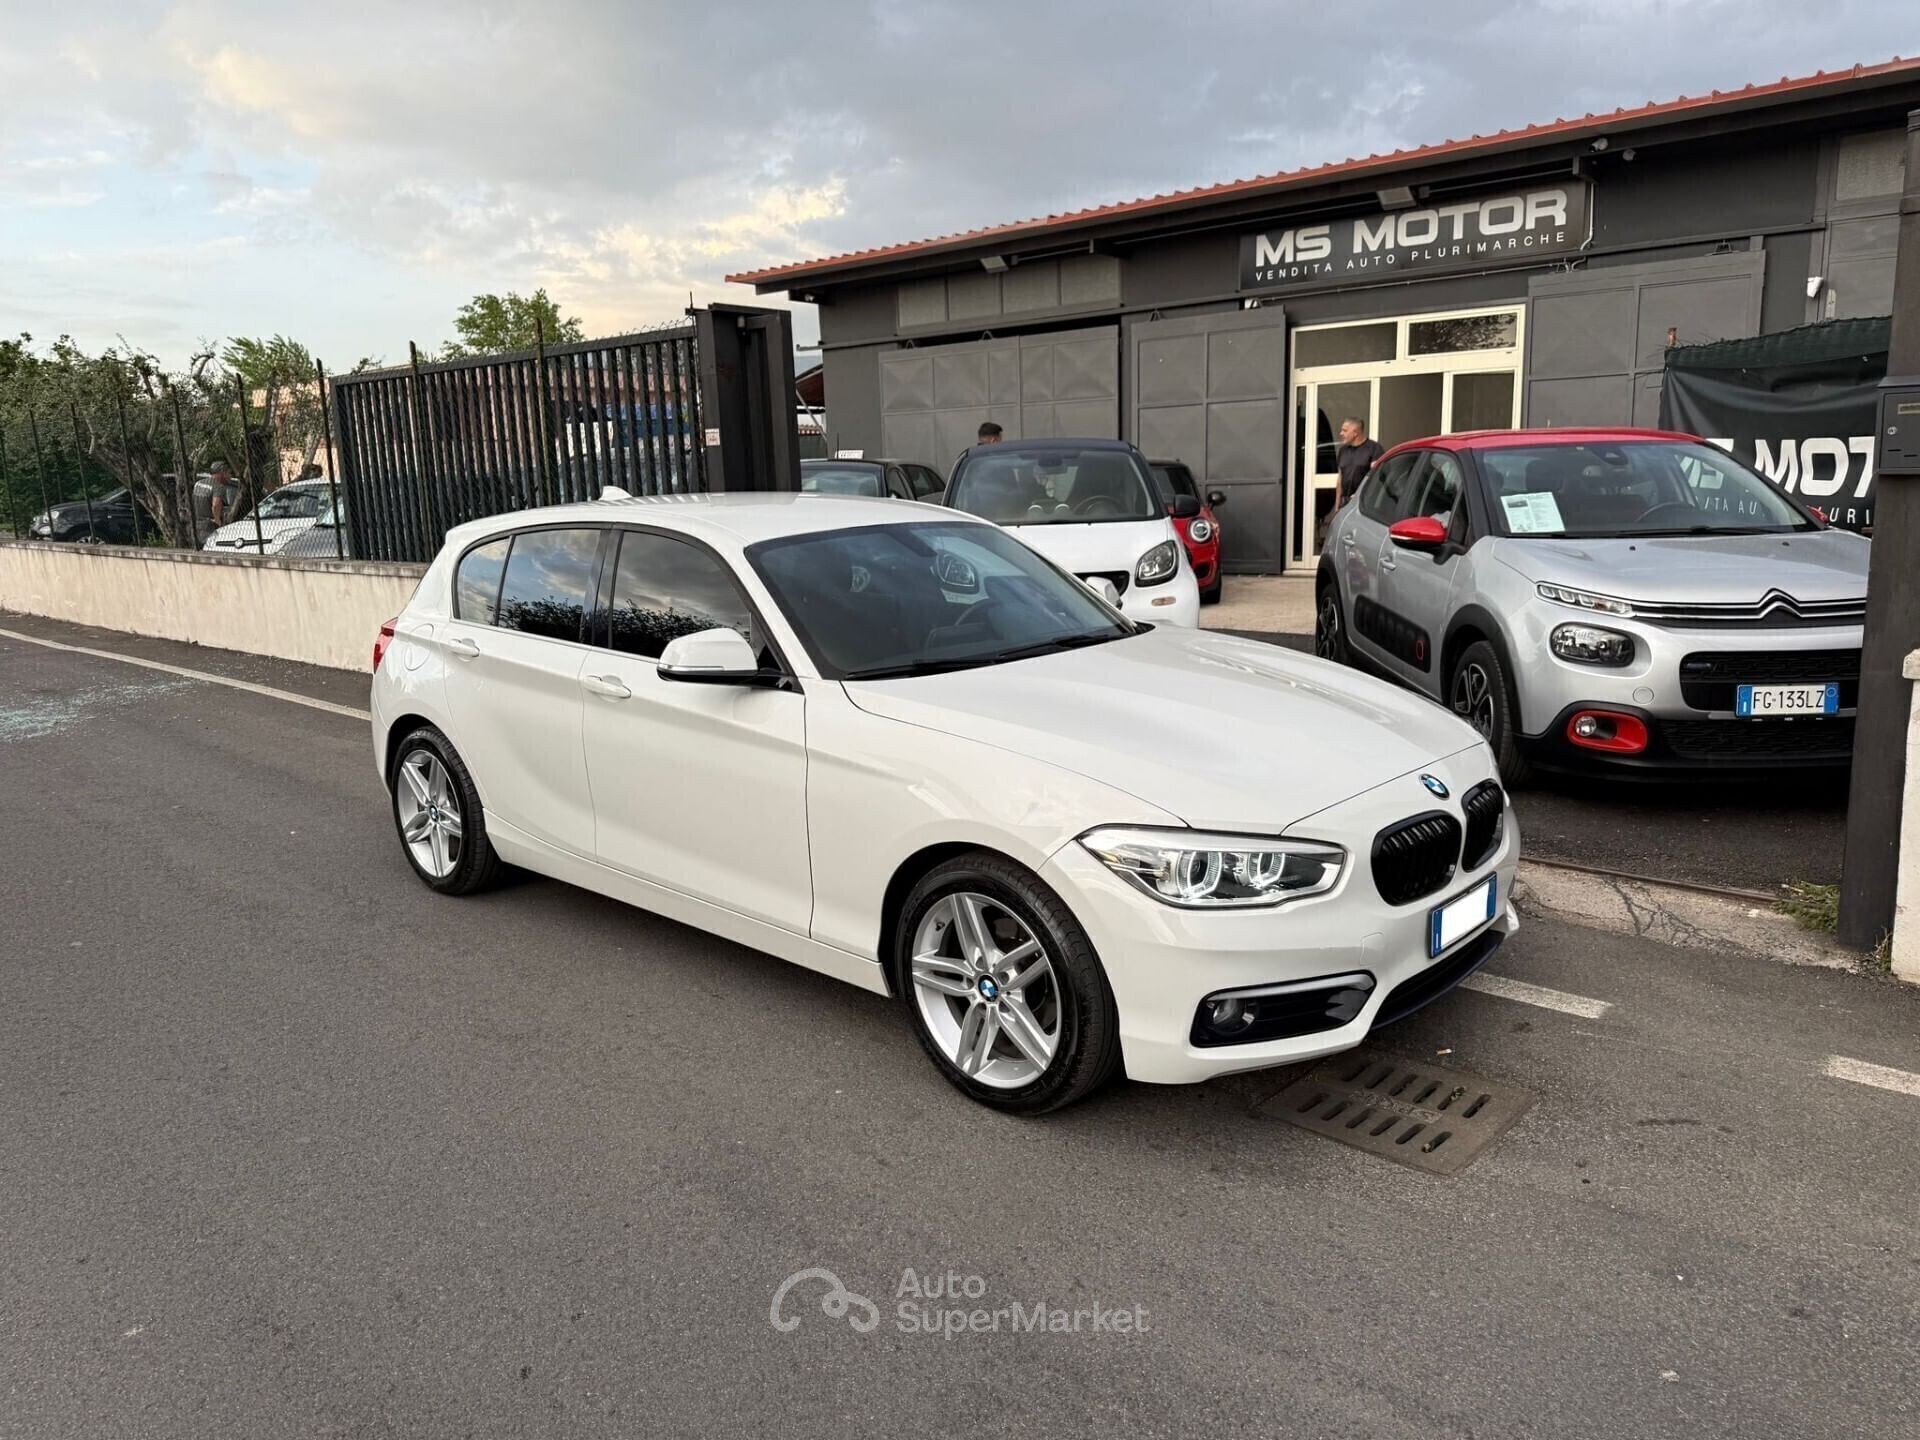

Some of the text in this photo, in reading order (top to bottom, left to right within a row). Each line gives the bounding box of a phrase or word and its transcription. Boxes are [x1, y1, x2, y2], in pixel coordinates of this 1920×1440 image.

[1255, 189, 1568, 267] MS MOTOR
[1255, 231, 1566, 282] VENDITA AUTO PLURIMARCHE
[1753, 436, 1875, 498] MOT
